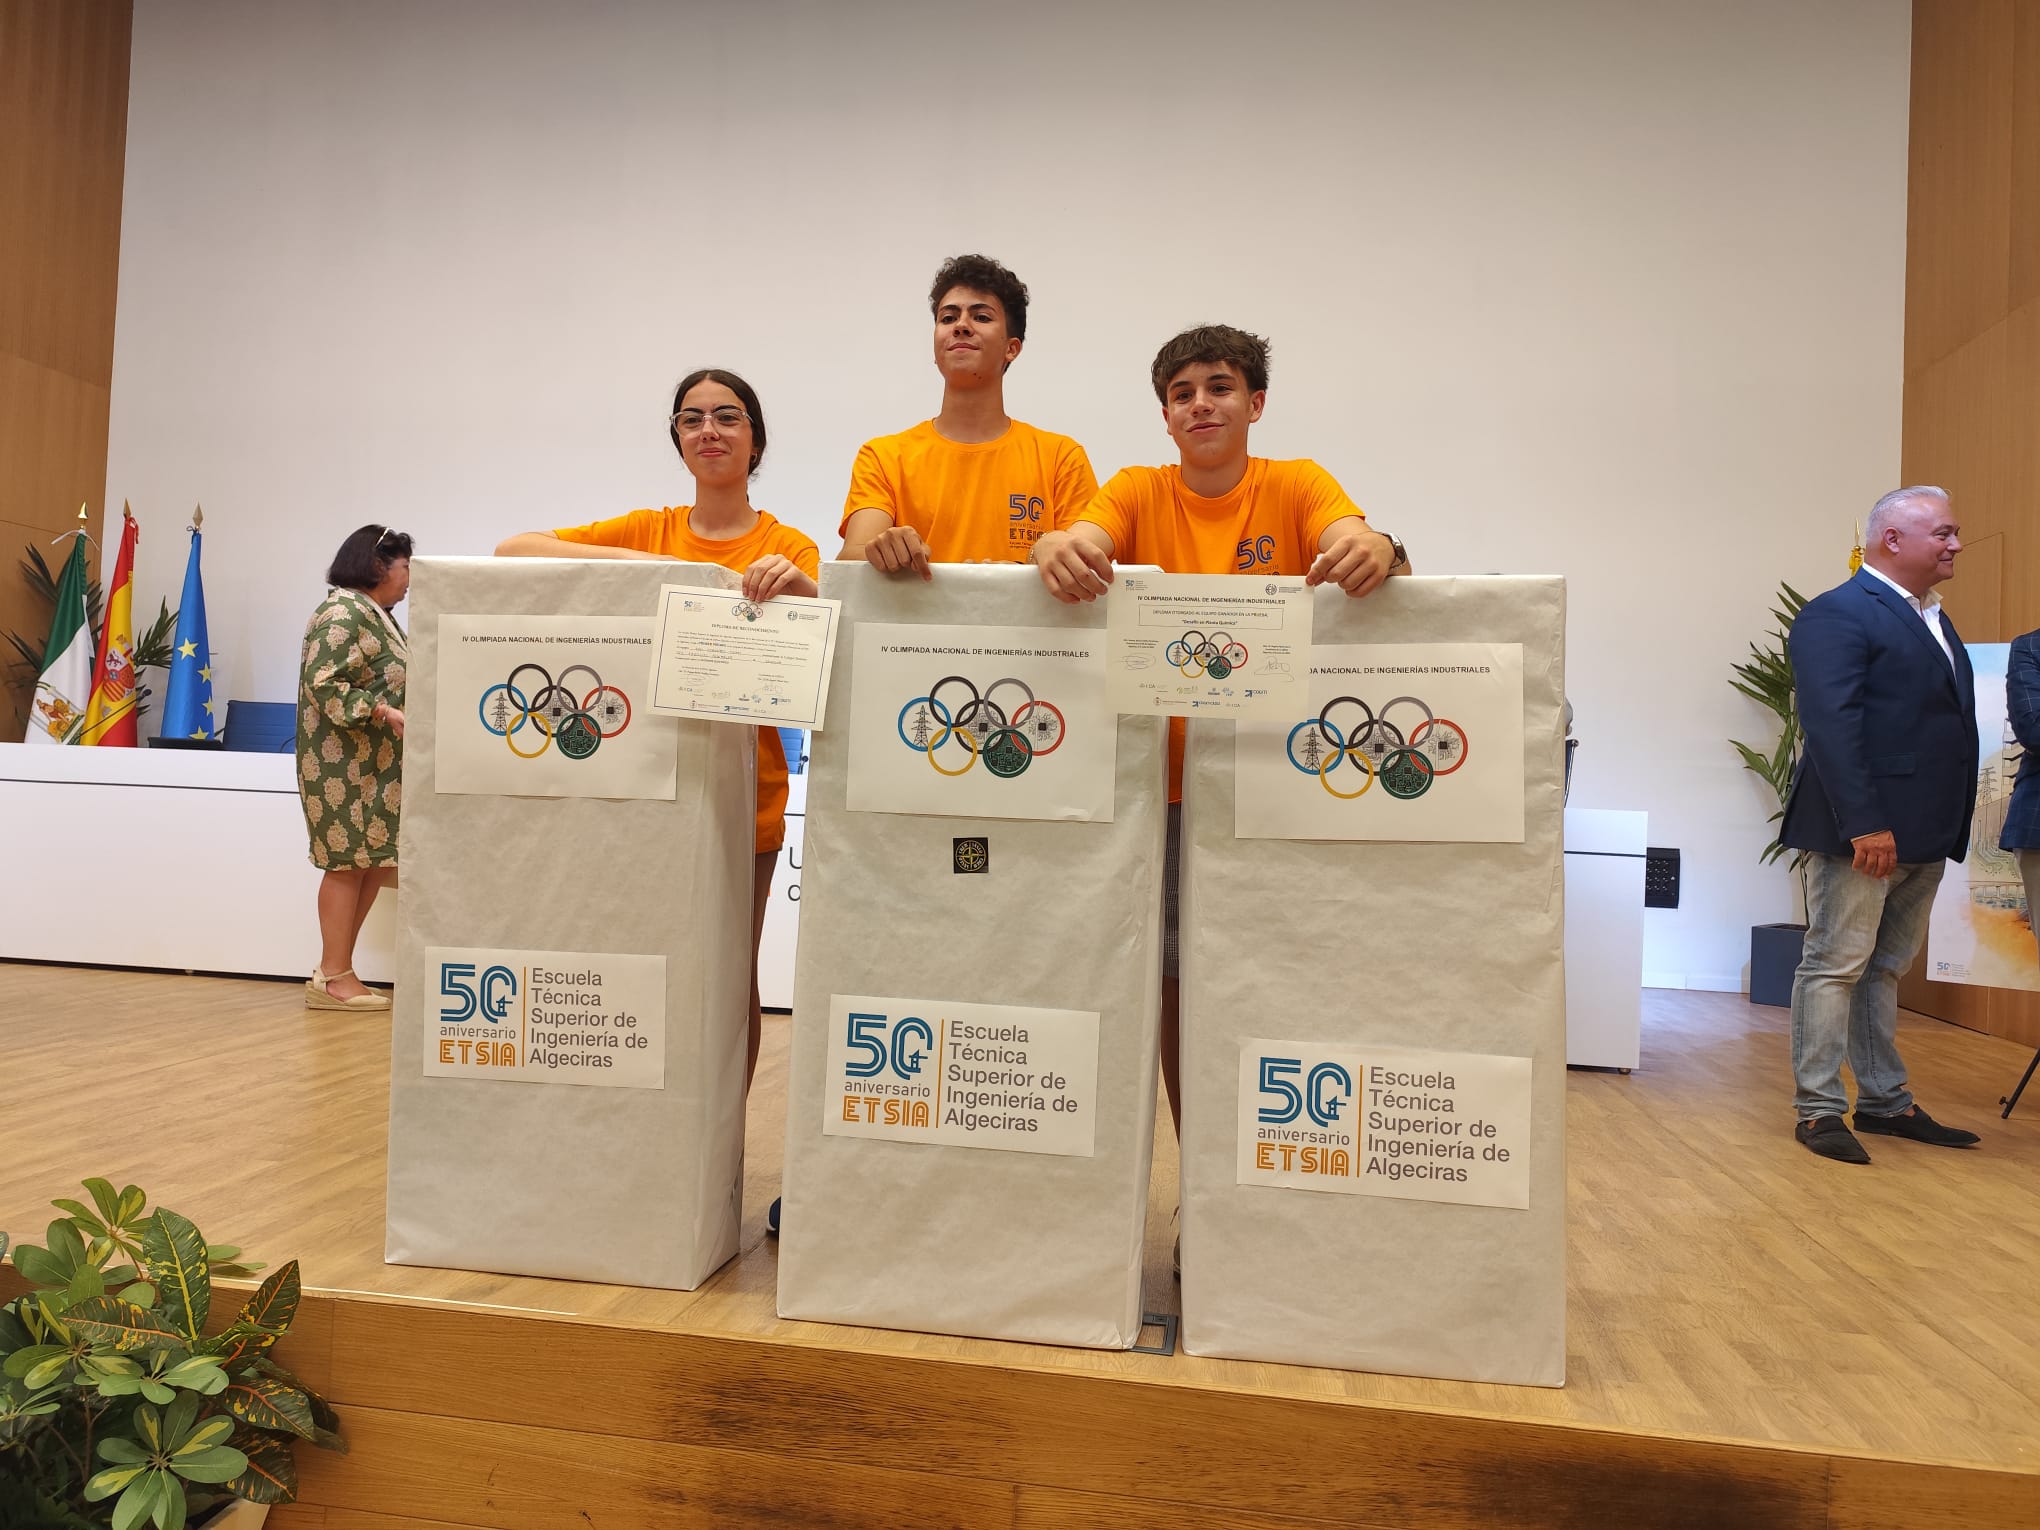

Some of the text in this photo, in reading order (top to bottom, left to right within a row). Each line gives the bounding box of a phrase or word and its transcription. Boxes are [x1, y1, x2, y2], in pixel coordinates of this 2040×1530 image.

[556, 635, 600, 644] INGENIERÍAS
[984, 648, 1032, 656] INGENIERÍAS
[532, 967, 602, 986] Escuela
[441, 963, 517, 1024] 50
[531, 988, 601, 1006] Técnica
[531, 1008, 637, 1028] Superior de
[440, 1024, 516, 1039] aniversario
[531, 1028, 648, 1049] Ingeniería de
[950, 1020, 1029, 1043] Escuela
[439, 1039, 516, 1067] ETSIA
[845, 1012, 933, 1080] 50
[949, 1042, 1028, 1065] Técnica
[529, 1048, 613, 1069] Algeciras
[844, 1080, 930, 1097] aniversario
[948, 1064, 1066, 1089] Superior de
[1370, 1066, 1456, 1090] Escuela
[947, 1086, 1078, 1112] Ingeniería de
[1258, 1057, 1351, 1128] 50
[1368, 1089, 1454, 1113] Técnica
[842, 1095, 929, 1128] ETSIA
[944, 1108, 1038, 1132] Algeciras
[1257, 1126, 1350, 1146] aniversario
[1368, 1111, 1497, 1138] Superior de
[1256, 1142, 1349, 1177] ETSIA
[1368, 1134, 1510, 1162] Ingeniería de
[1366, 1157, 1468, 1182] Algeciras
